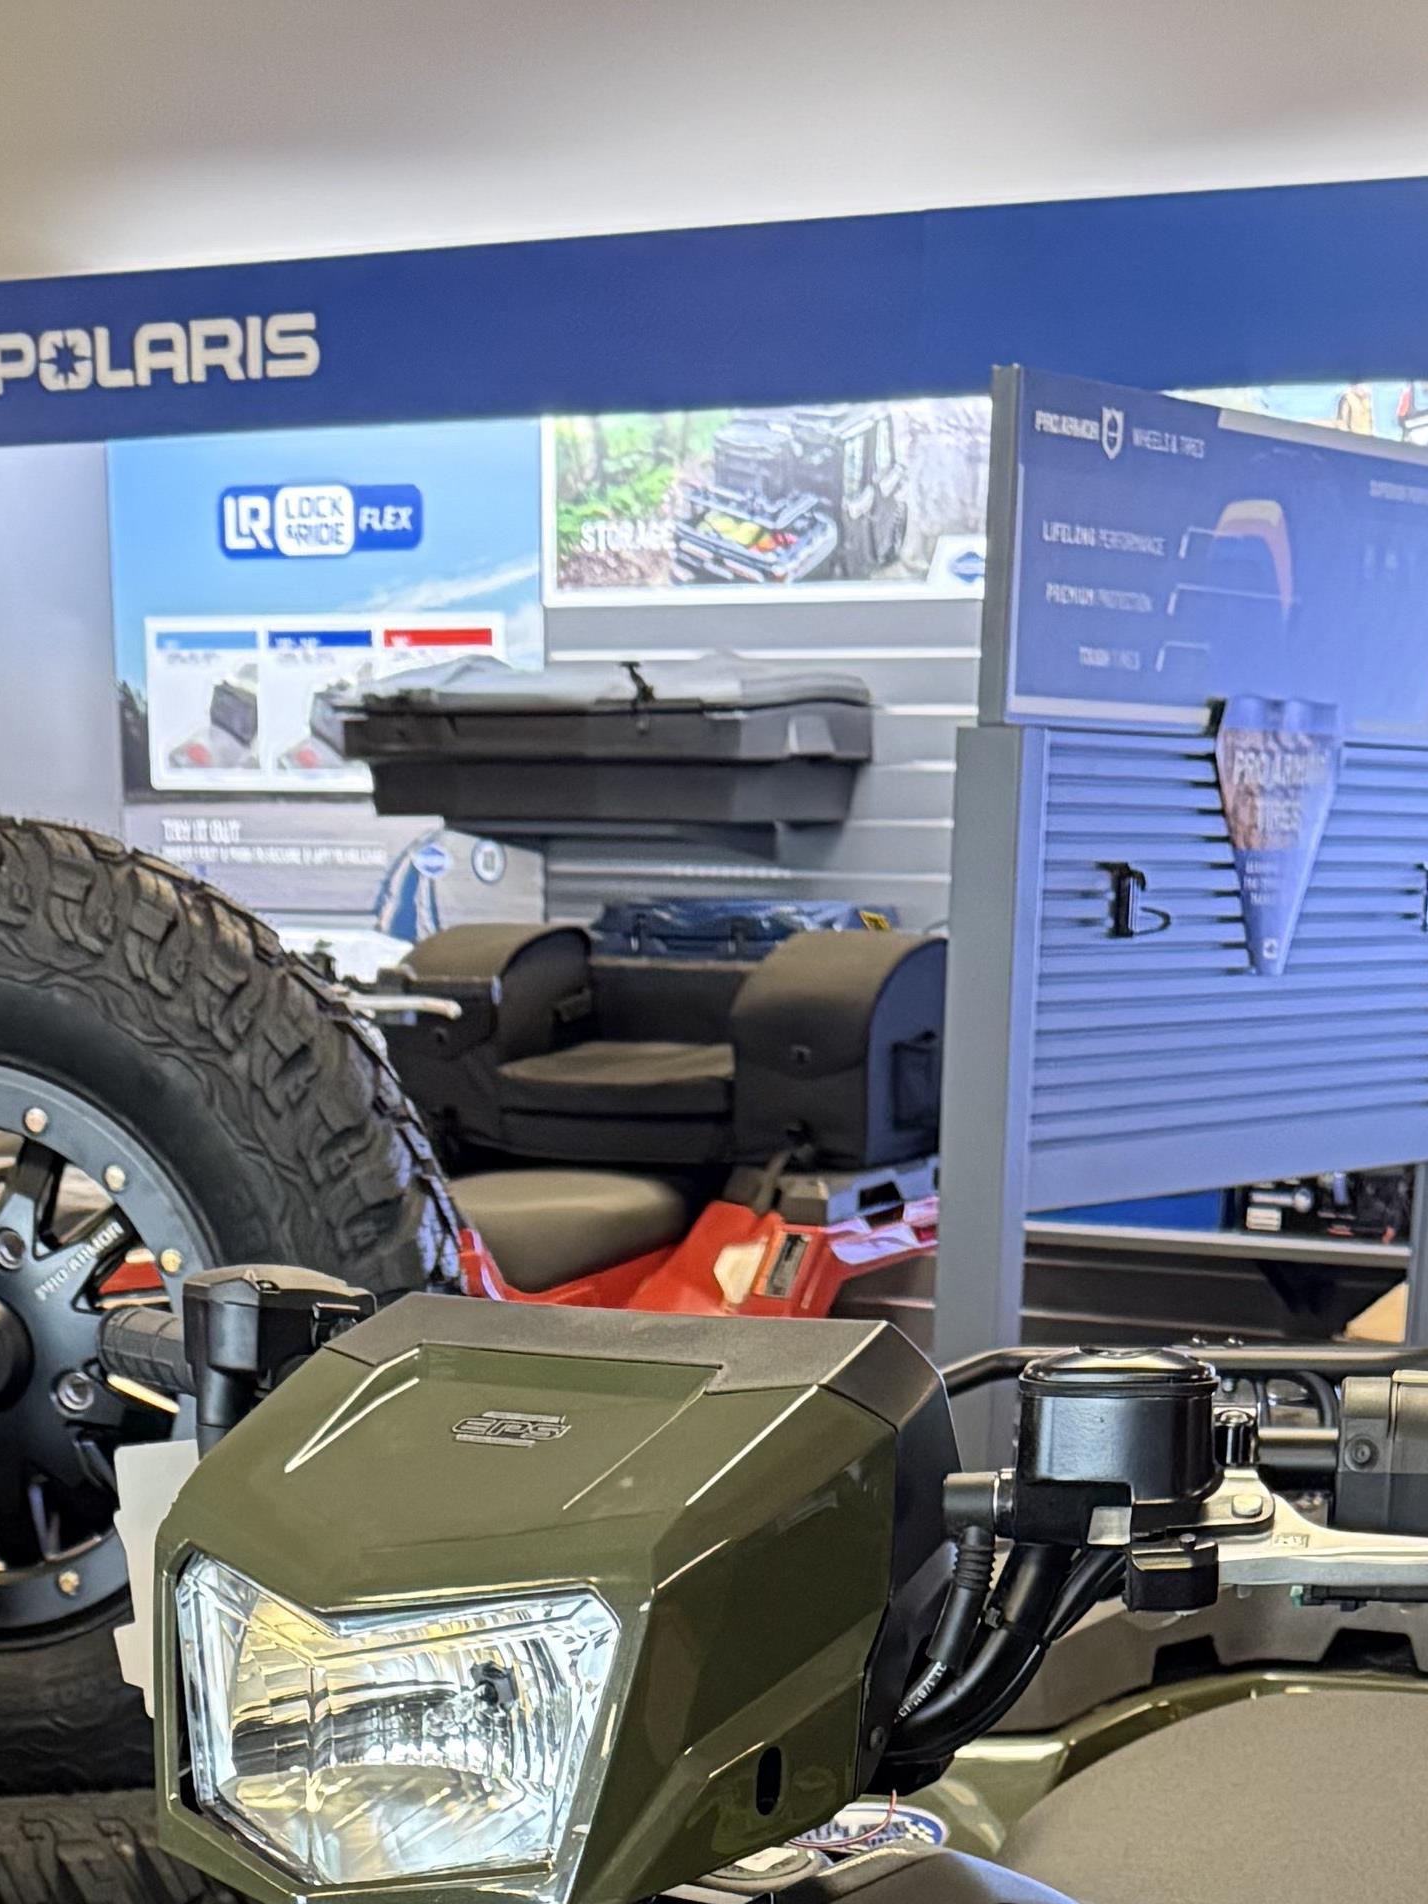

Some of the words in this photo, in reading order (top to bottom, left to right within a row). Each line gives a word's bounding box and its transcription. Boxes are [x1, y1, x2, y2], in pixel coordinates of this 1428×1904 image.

[284, 496, 345, 520] LOCK
[359, 505, 414, 532] FLEX
[580, 519, 677, 553] STORAGE
[1042, 520, 1097, 547] LIFELONG
[1045, 582, 1095, 606] PREMIUM
[34, 1268, 69, 1301] PRO
[68, 1221, 125, 1272] ARMOR
[452, 1416, 571, 1441] EPS
